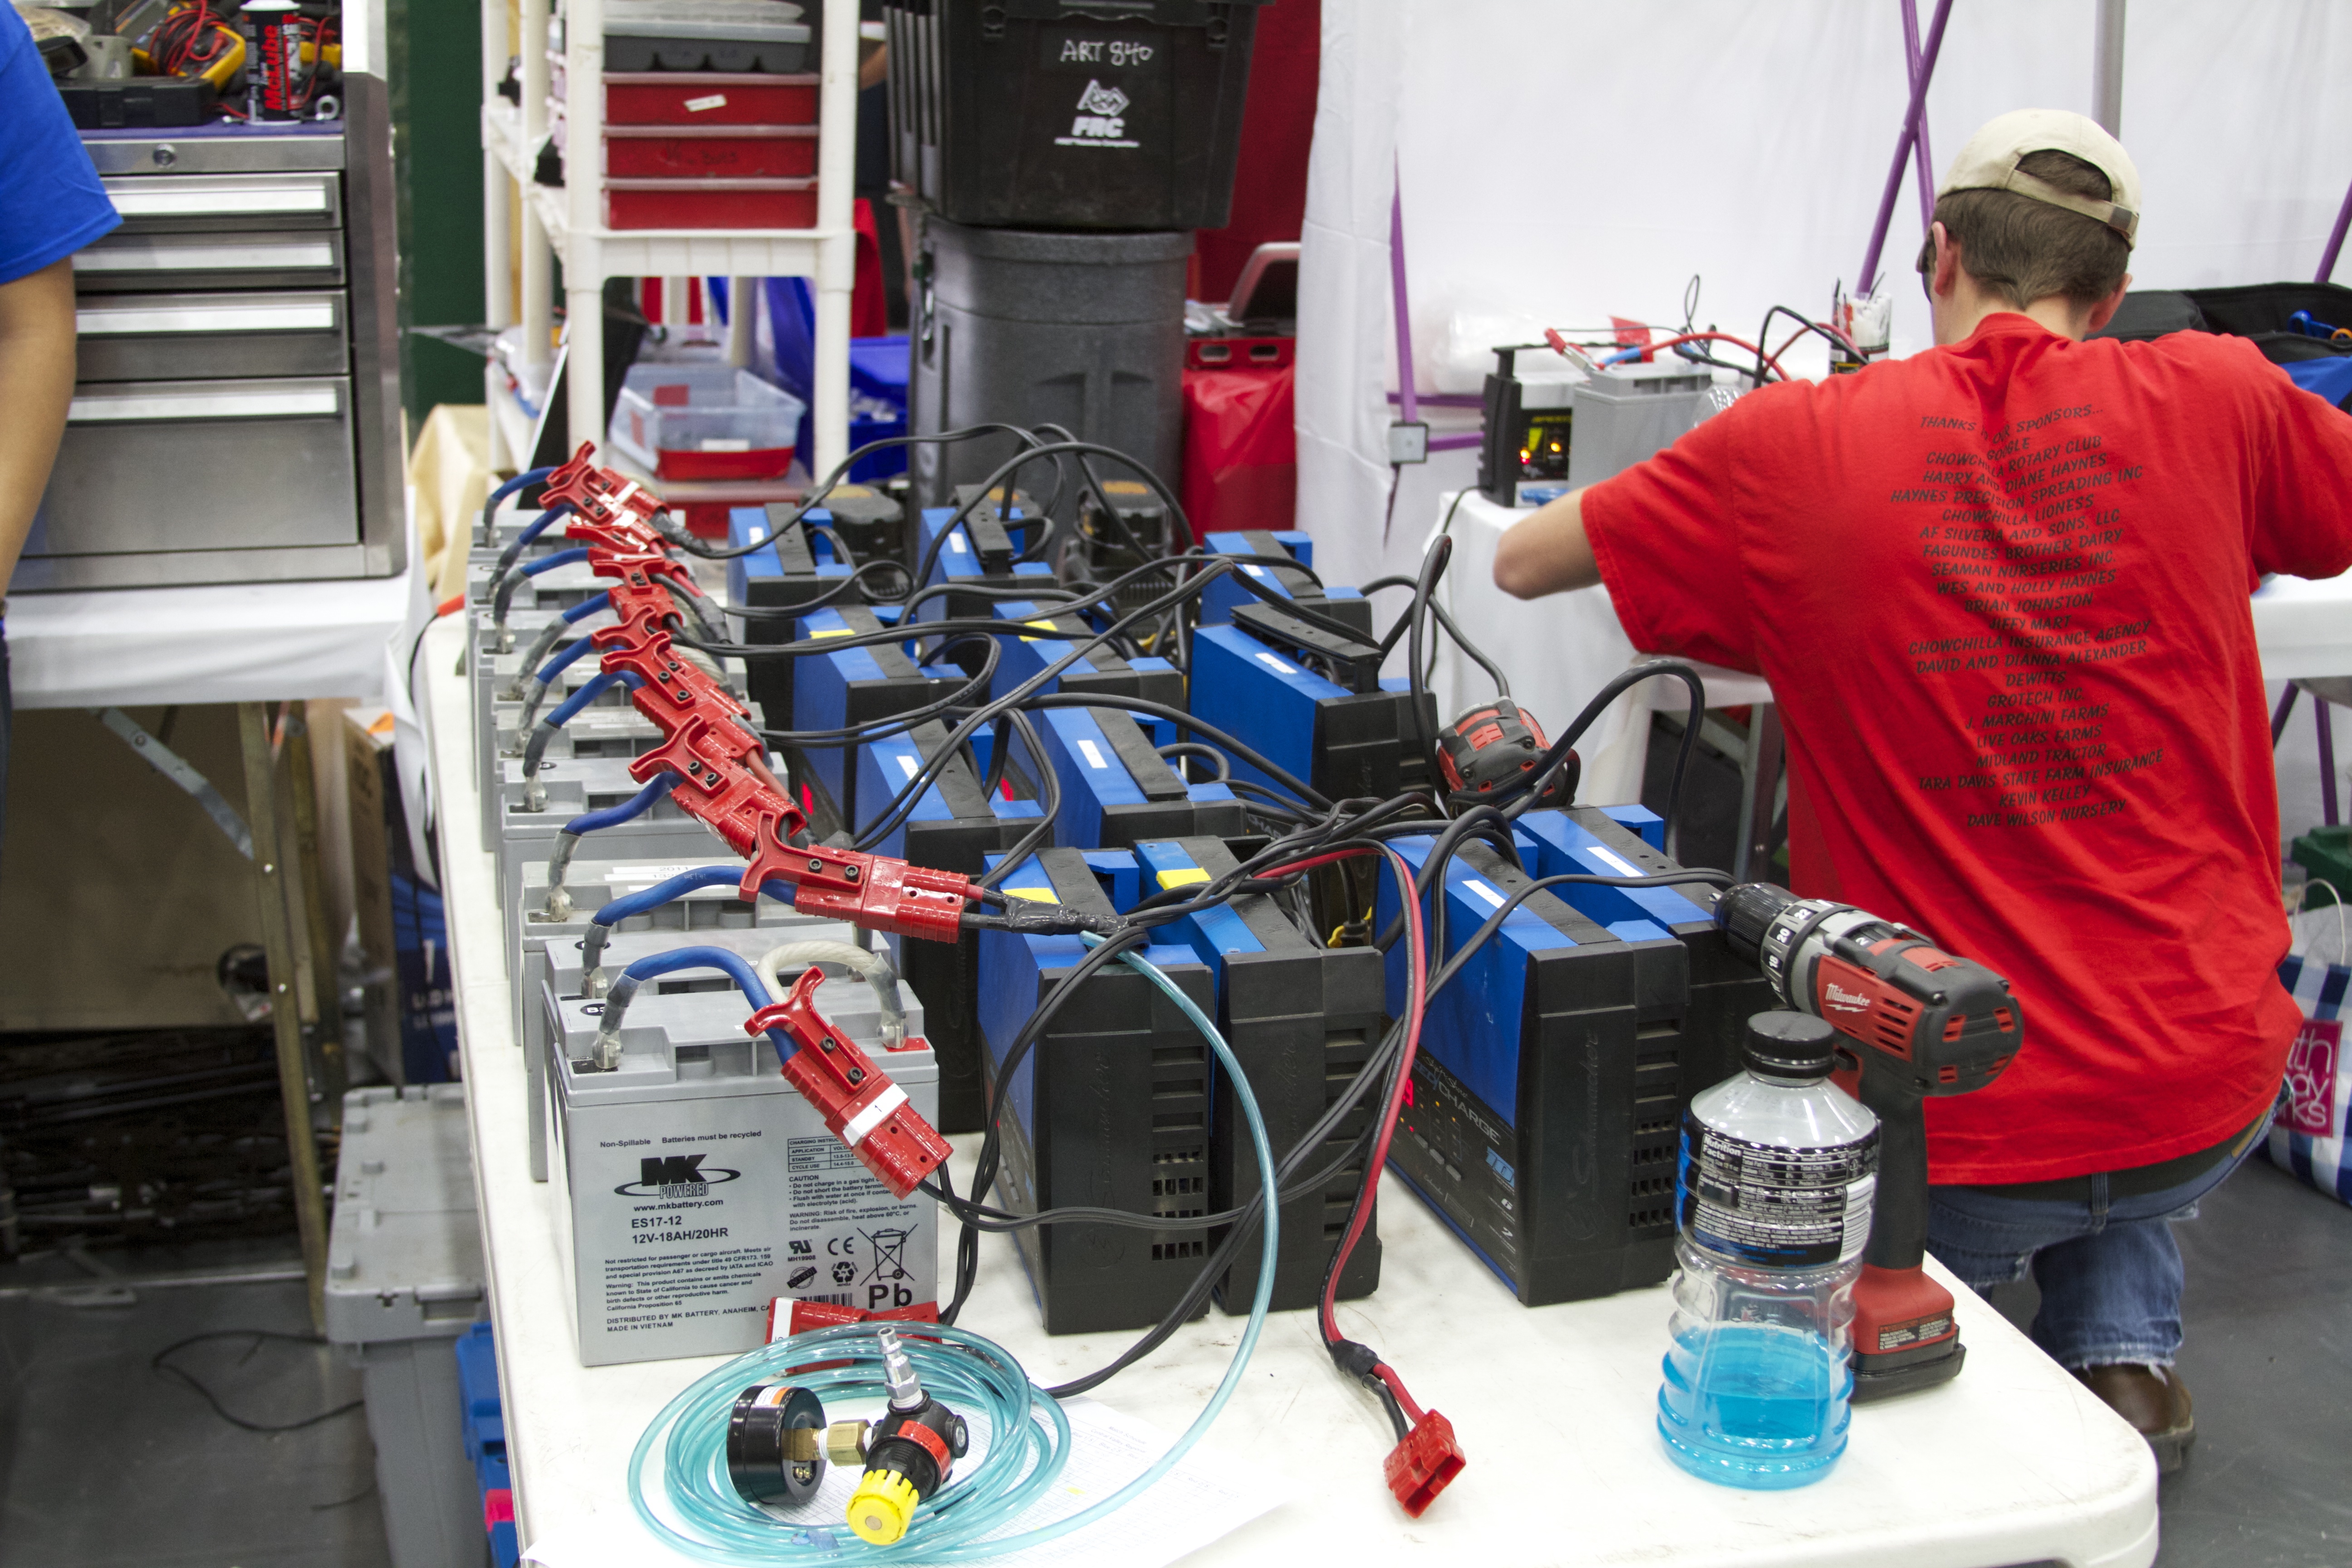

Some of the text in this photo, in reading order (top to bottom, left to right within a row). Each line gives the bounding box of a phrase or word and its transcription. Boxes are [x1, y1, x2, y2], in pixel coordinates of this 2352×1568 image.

[1060, 39, 1105, 62] ART
[1921, 416, 1976, 430] THANKS
[1927, 436, 2102, 477] CHOWCHILLA ROTARY CLUB
[1987, 437, 2030, 461] GOOGLE
[1923, 453, 2107, 494] HARRY AND DIANE HAYNES
[1891, 466, 2142, 511] HAYNES PRECISION SPREADING INC
[1942, 494, 2094, 525] CHOWCHILLA LIONESS
[1919, 526, 1940, 539] AF
[1944, 527, 2003, 542] SILVERIA
[2009, 528, 2042, 541] AND
[2096, 509, 2120, 525] LLC
[1923, 528, 2123, 560] FAGUNDES BROTHER DAIRY
[1931, 563, 1991, 577] SEAMAN
[1998, 555, 2082, 577] NURSERIES
[1937, 568, 2116, 594] WES AND HOLLY HAYNES
[1965, 592, 2093, 612] BRIAN JOHNSTON
[1989, 615, 2072, 630] JIFFY MART
[1909, 620, 2151, 655] CHOWCHILLA INSURANCE AGENCY
[1917, 640, 2146, 673] DAVID AND DIANNA ALEXANDER
[2006, 671, 2066, 686] DEWITTS
[1987, 690, 2053, 707] GROTECH
[1982, 709, 2055, 728] MARCHINI
[2061, 703, 2109, 722] FARMS
[1977, 723, 2102, 748] LIVE OAKS FARMS
[1976, 743, 2107, 768] MIDLAND TRACTOR
[1919, 749, 2163, 790] TARA DAVIS STATE FARM INSURANCE
[1999, 784, 2091, 808] KEVIN KELLEY
[1968, 799, 2126, 827] DAVE WILSON NURSERY
[1793, 908, 1812, 920] 22
[1776, 927, 1791, 944] 20
[1855, 937, 1870, 946] 2
[1769, 954, 1780, 968] 18
[1825, 982, 1871, 1007] Milwaukee
[874, 1104, 882, 1112] 1
[600, 1139, 651, 1148] Non-Spillable
[730, 1130, 762, 1139] recycled
[1703, 1144, 1725, 1160] Facts
[1704, 1136, 1742, 1156] Nutrition
[641, 1154, 707, 1186] MK
[659, 1182, 709, 1199] POWERED
[633, 1200, 724, 1212] www.mkbattery.com
[632, 1215, 682, 1229] ES17-12
[632, 1227, 728, 1244] 12V-18AH/20HR
[650, 1261, 691, 1269] requirements
[868, 1283, 913, 1309] Pb
[607, 1315, 657, 1324] DISTRIBUTED
[722, 1306, 759, 1314] ANAHEIM,
